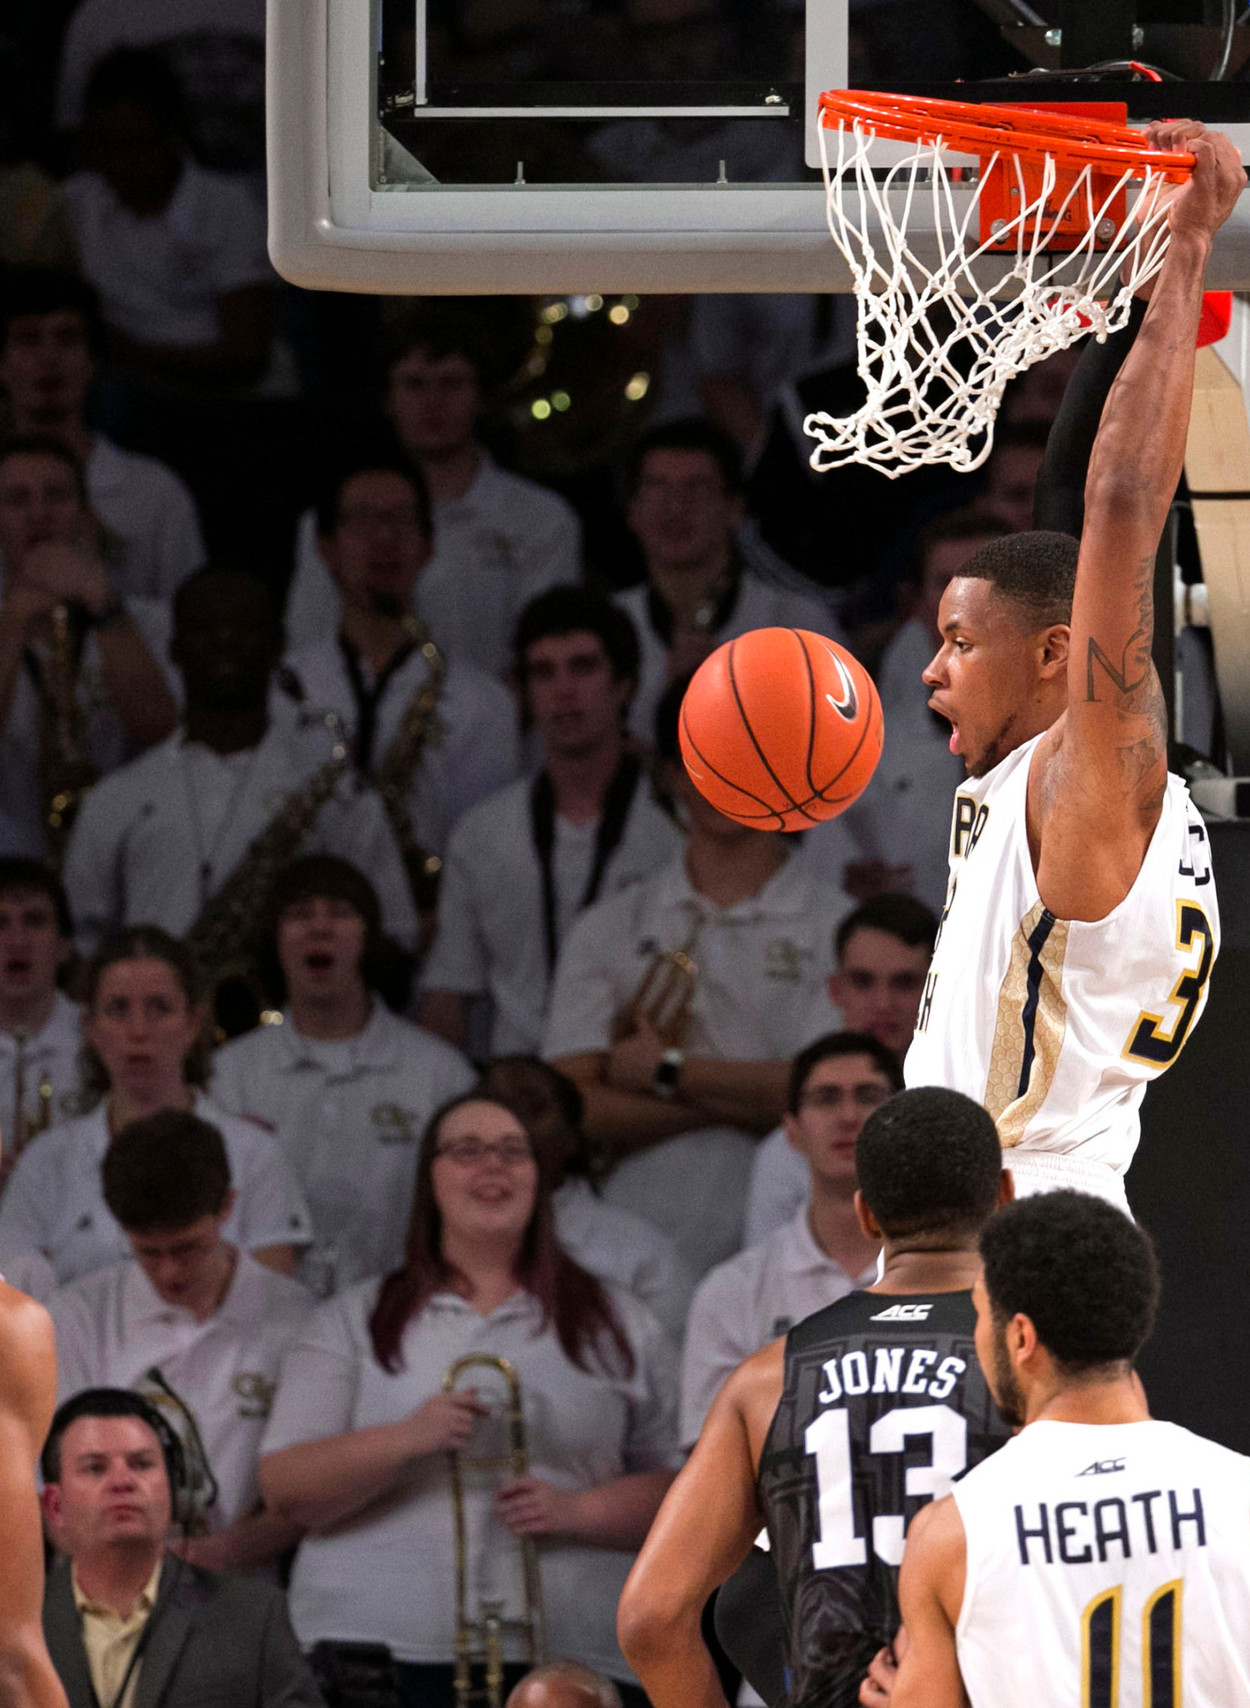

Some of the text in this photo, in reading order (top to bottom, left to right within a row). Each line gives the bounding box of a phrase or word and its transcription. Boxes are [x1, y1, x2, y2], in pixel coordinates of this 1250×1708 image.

[869, 1303, 933, 1321] ACC
[818, 1348, 967, 1404] JONES
[804, 1404, 968, 1571] 13
[1075, 1457, 1127, 1477] ACC
[1014, 1488, 1207, 1565] HEATH
[1080, 1577, 1184, 1708] 11
